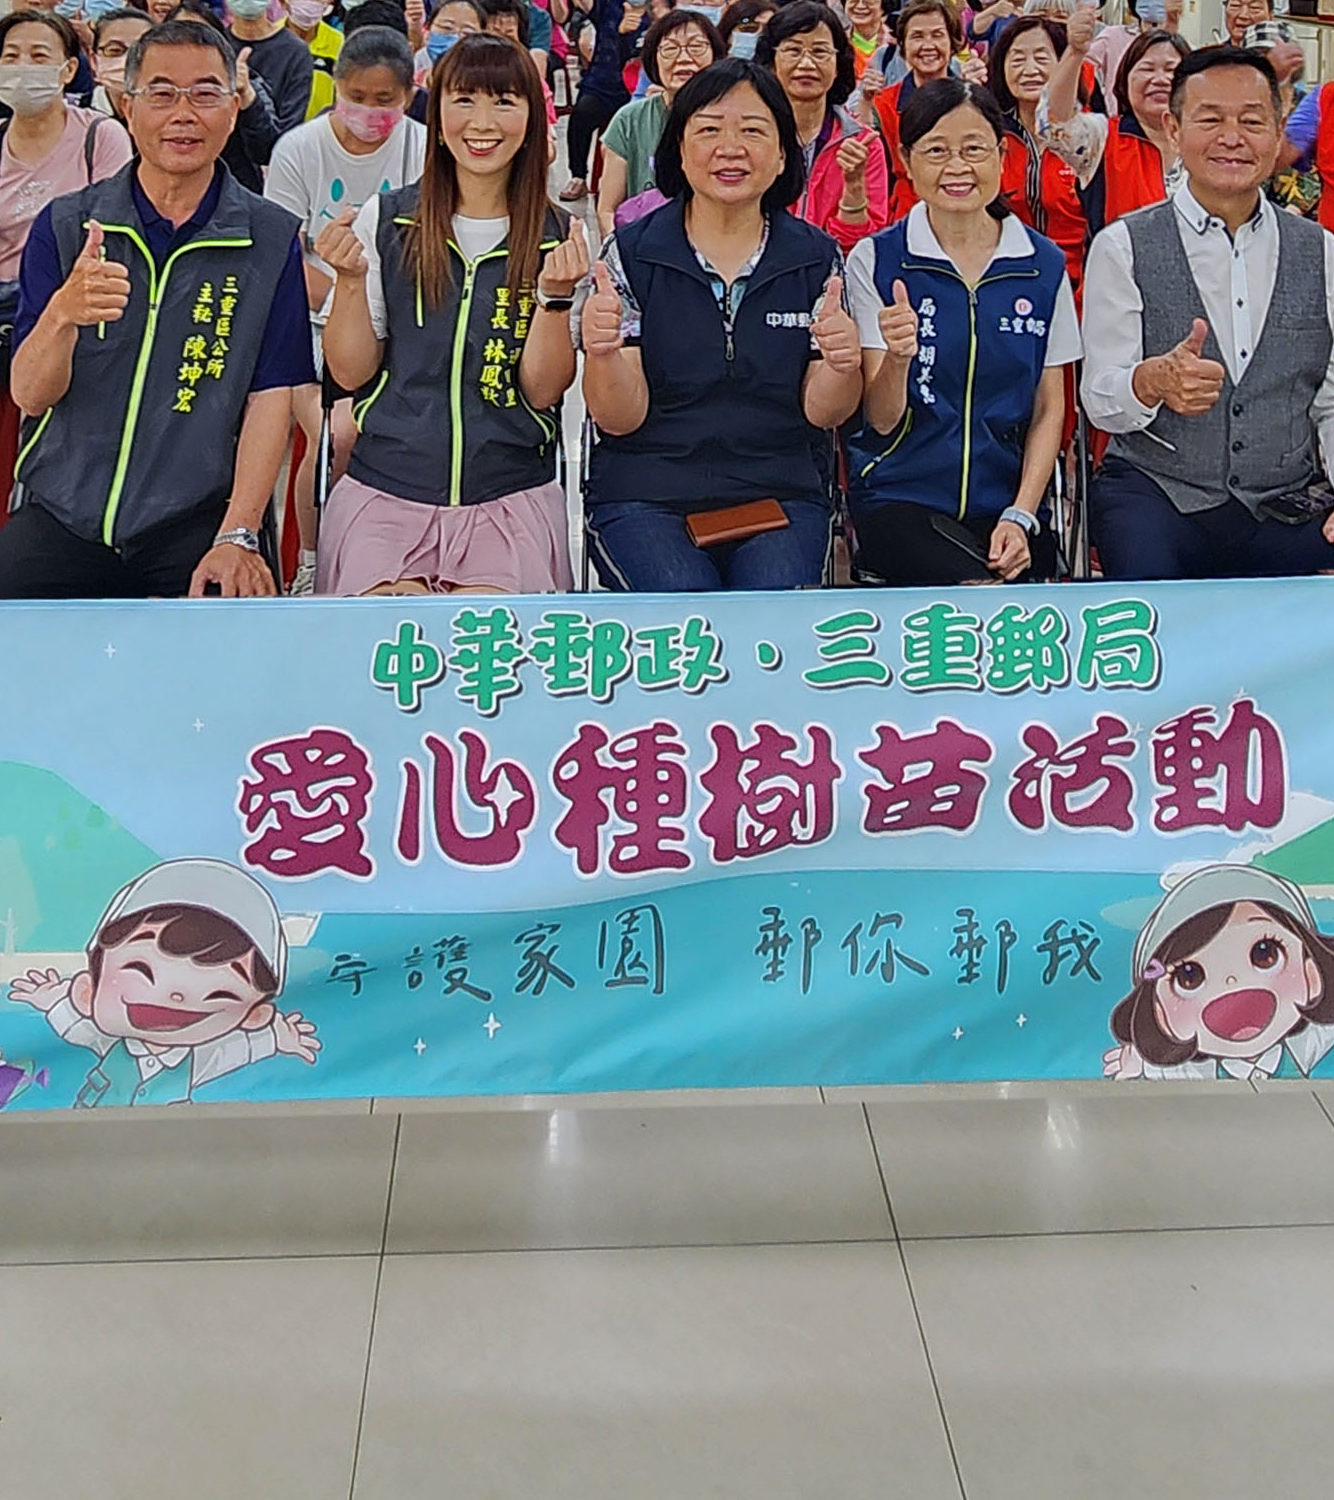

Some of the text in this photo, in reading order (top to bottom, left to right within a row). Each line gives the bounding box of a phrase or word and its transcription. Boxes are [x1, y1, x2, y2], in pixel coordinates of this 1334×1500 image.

[192, 282, 214, 323] 主秘
[205, 276, 239, 379] 三重區公所
[490, 287, 511, 330] 里長
[917, 298, 937, 338] 局長
[241, 700, 1284, 880] 愛心種樹苗活動
[326, 904, 1101, 1001] 守護家園 郵你郵我
